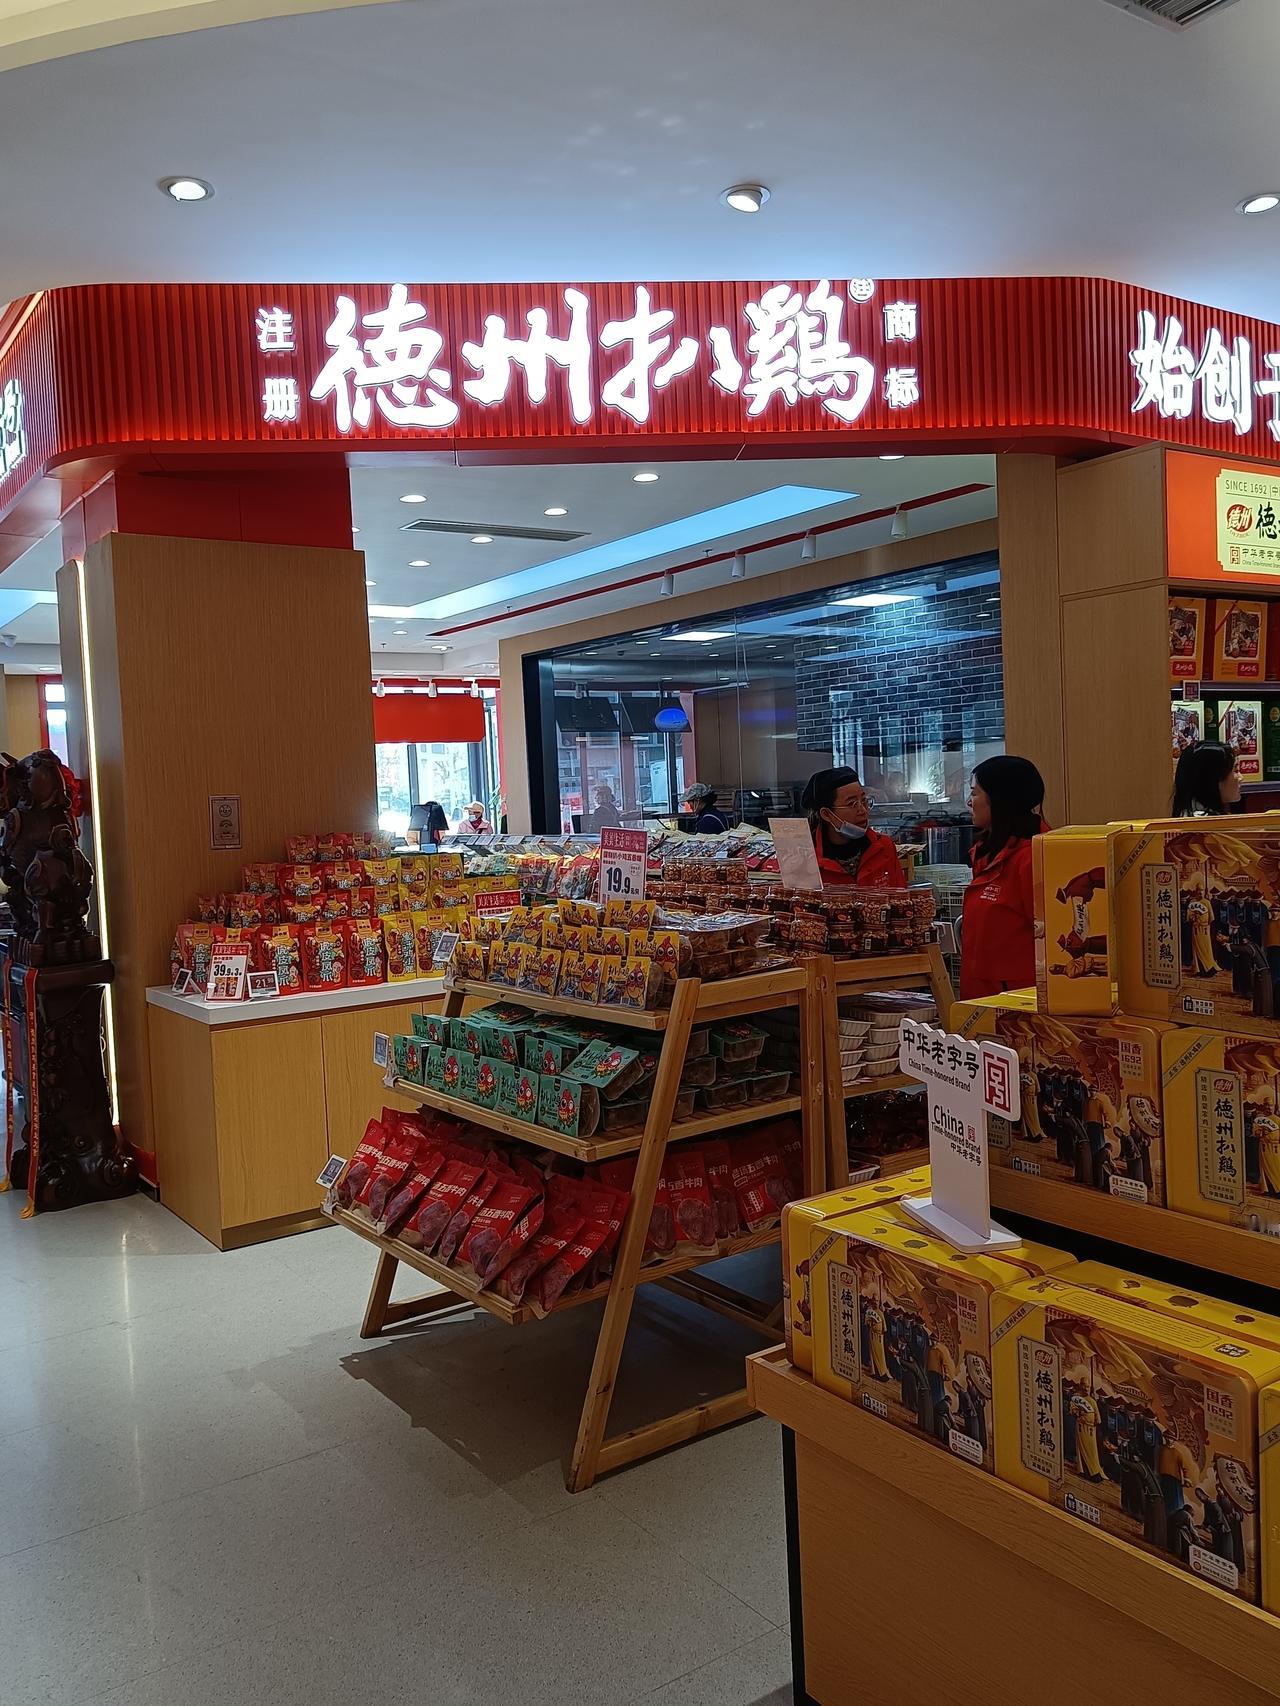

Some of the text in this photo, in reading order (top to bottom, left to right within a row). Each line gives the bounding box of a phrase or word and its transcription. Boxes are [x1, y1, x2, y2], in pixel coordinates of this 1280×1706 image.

[256, 308, 299, 422] 注册
[1225, 479, 1267, 495] SINCE 1692
[1255, 502, 1280, 539] 德
[902, 1028, 980, 1079] 中华老字号
[1121, 1053, 1142, 1065] 1692
[908, 1058, 922, 1071] China
[955, 1076, 971, 1092] Brand
[933, 1104, 965, 1137] China
[950, 1142, 982, 1167] 中华老字号
[965, 1139, 981, 1155] Brand
[1206, 1402, 1234, 1421] 1692
